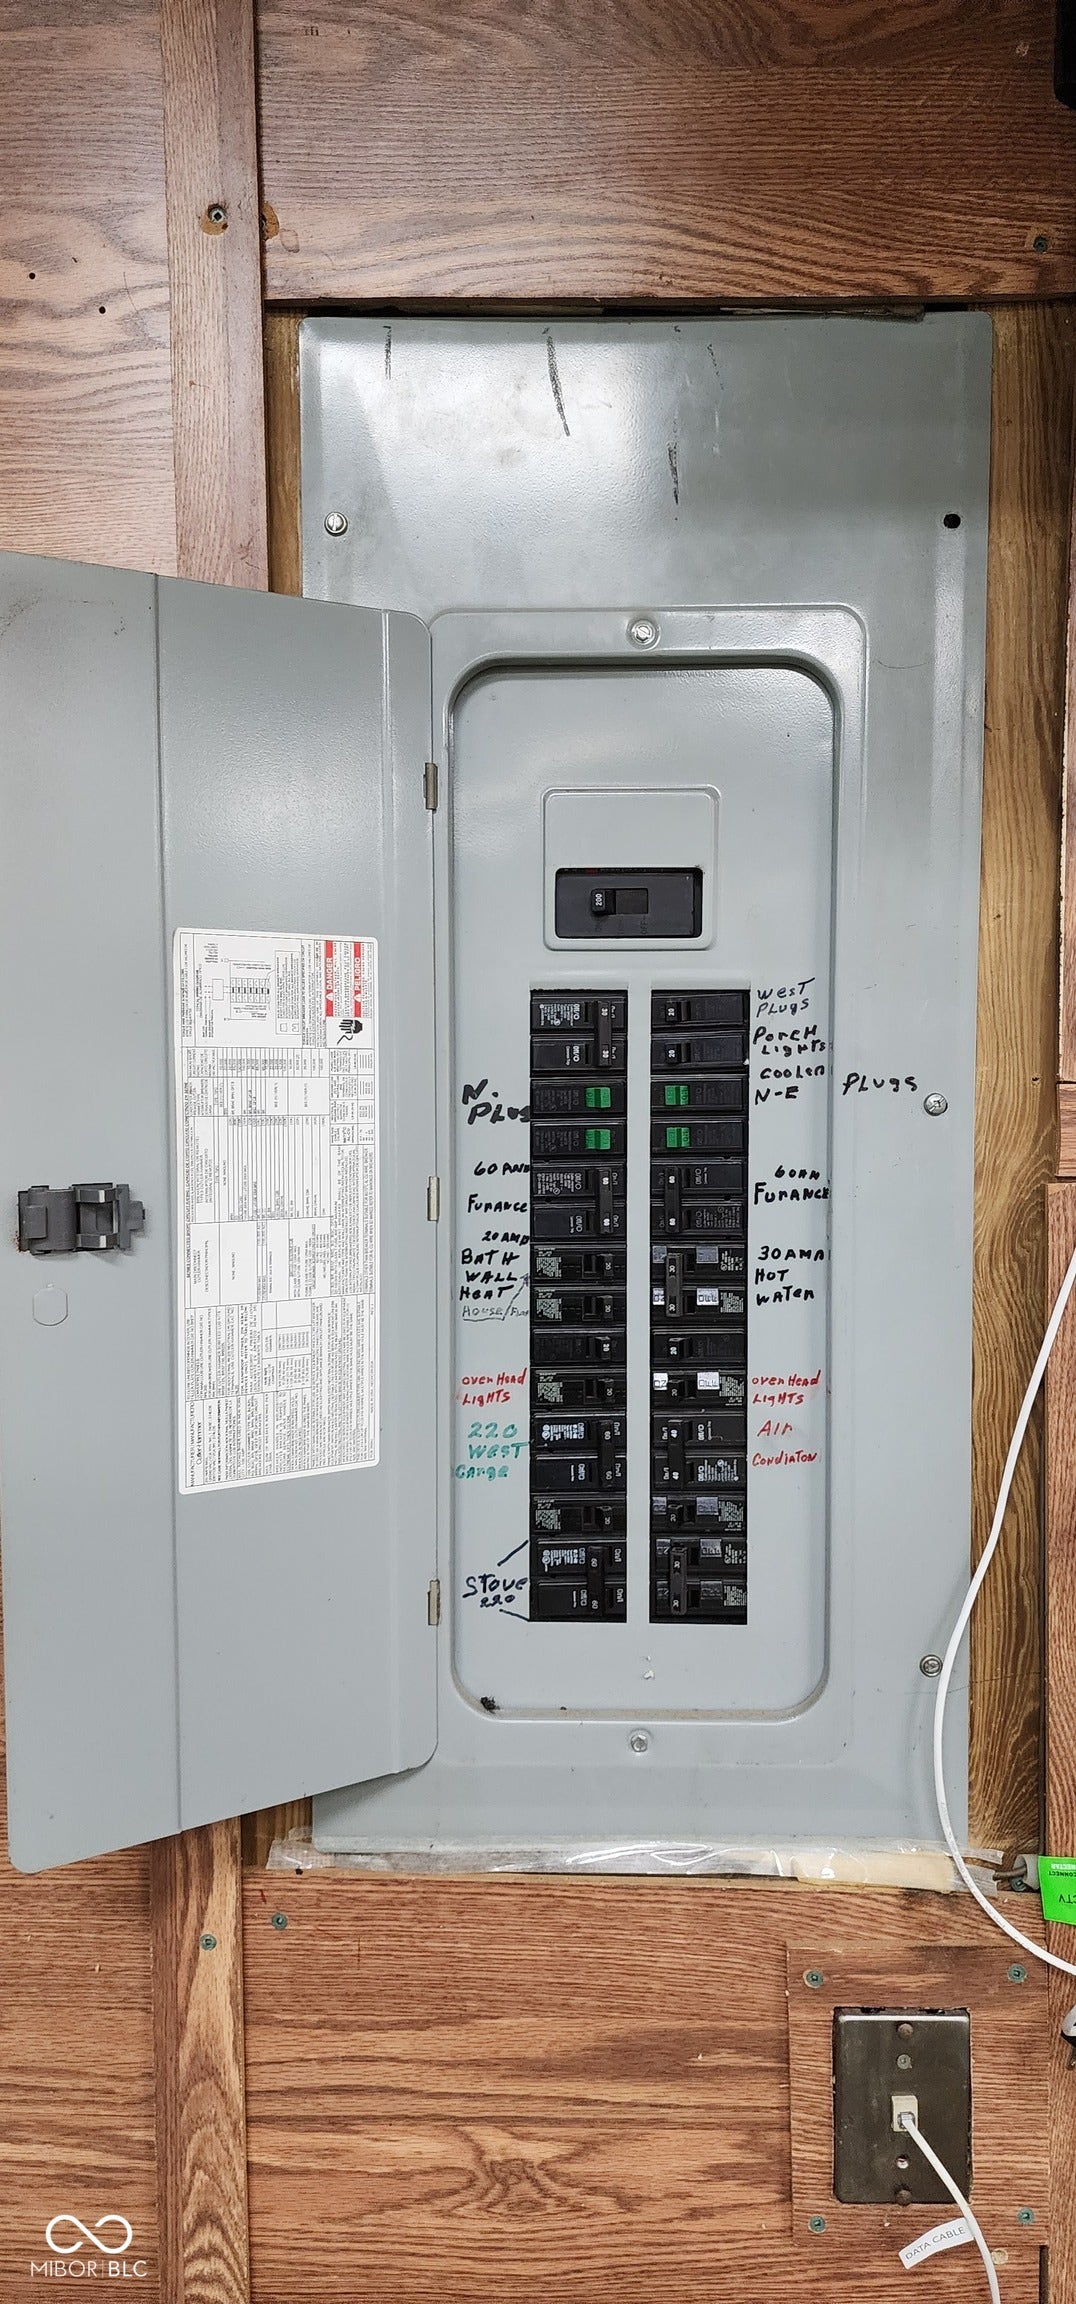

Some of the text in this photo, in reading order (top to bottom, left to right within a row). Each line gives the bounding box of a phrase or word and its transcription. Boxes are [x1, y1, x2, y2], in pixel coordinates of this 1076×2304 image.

[668, 1008, 675, 1016] 20
[668, 1050, 676, 1058] 20
[754, 1086, 800, 1105] N-E
[474, 1161, 498, 1176] 60
[466, 1270, 518, 1284] WALL
[754, 1268, 790, 1285] HOT
[603, 1343, 610, 1352] 20
[670, 1346, 678, 1355] 20
[468, 1422, 518, 1438] 220
[604, 1430, 611, 1440] 60
[670, 1429, 678, 1438] 40
[605, 1470, 612, 1480] 60
[591, 1558, 598, 1567] 60
[592, 1600, 598, 1609] 60
[905, 2226, 966, 2260] DATA CABLE
